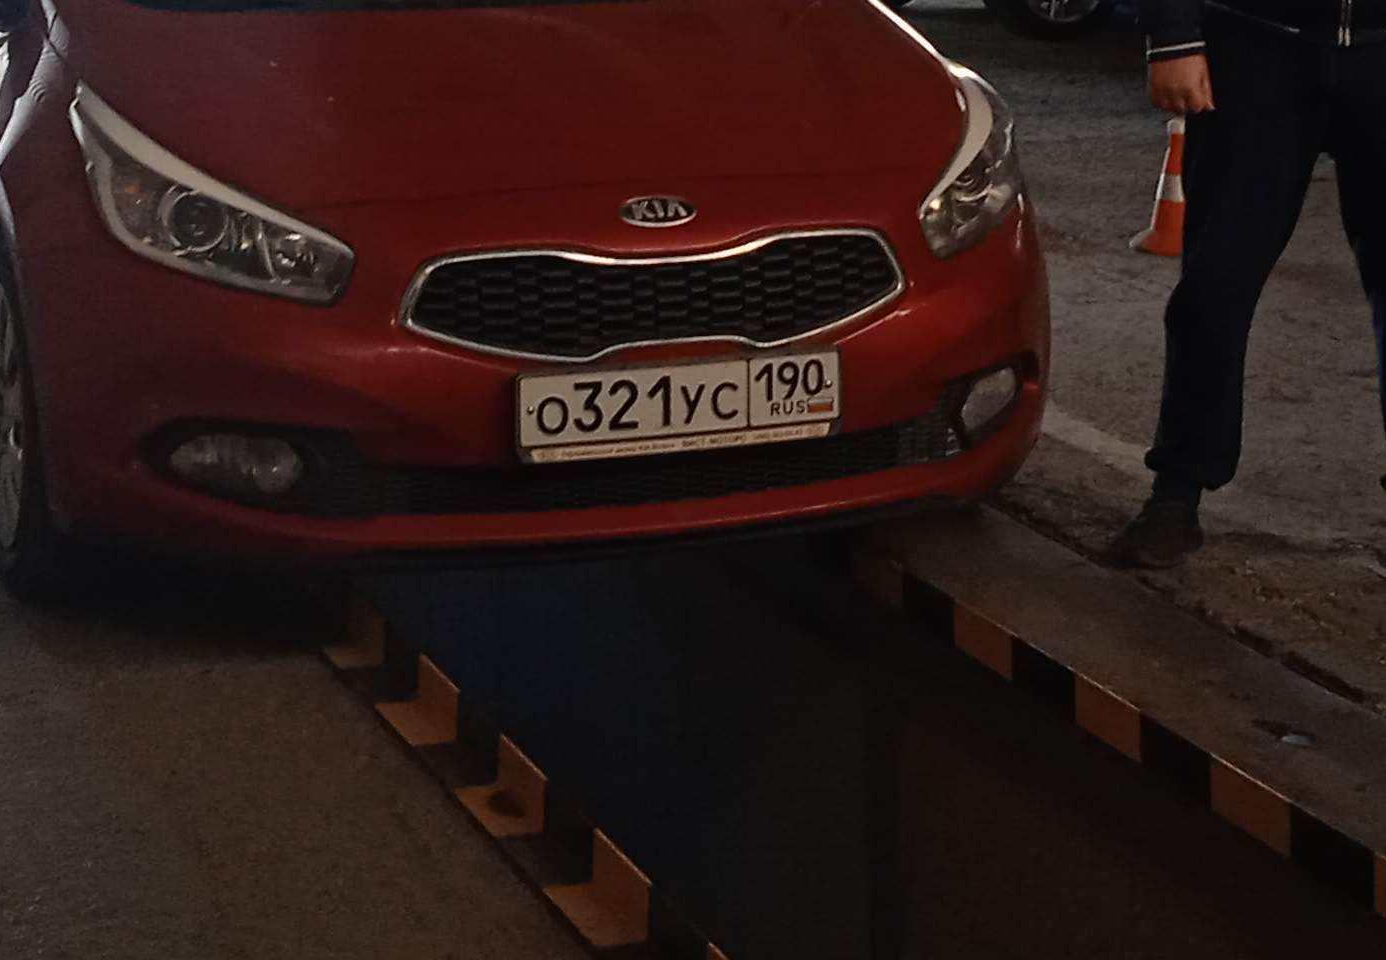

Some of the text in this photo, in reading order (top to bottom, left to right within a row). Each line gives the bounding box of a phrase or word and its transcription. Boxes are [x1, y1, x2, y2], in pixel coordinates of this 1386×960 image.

[631, 199, 688, 220] KIA
[753, 358, 826, 402] 190
[535, 375, 740, 435] О321УС
[769, 398, 809, 417] RUS
